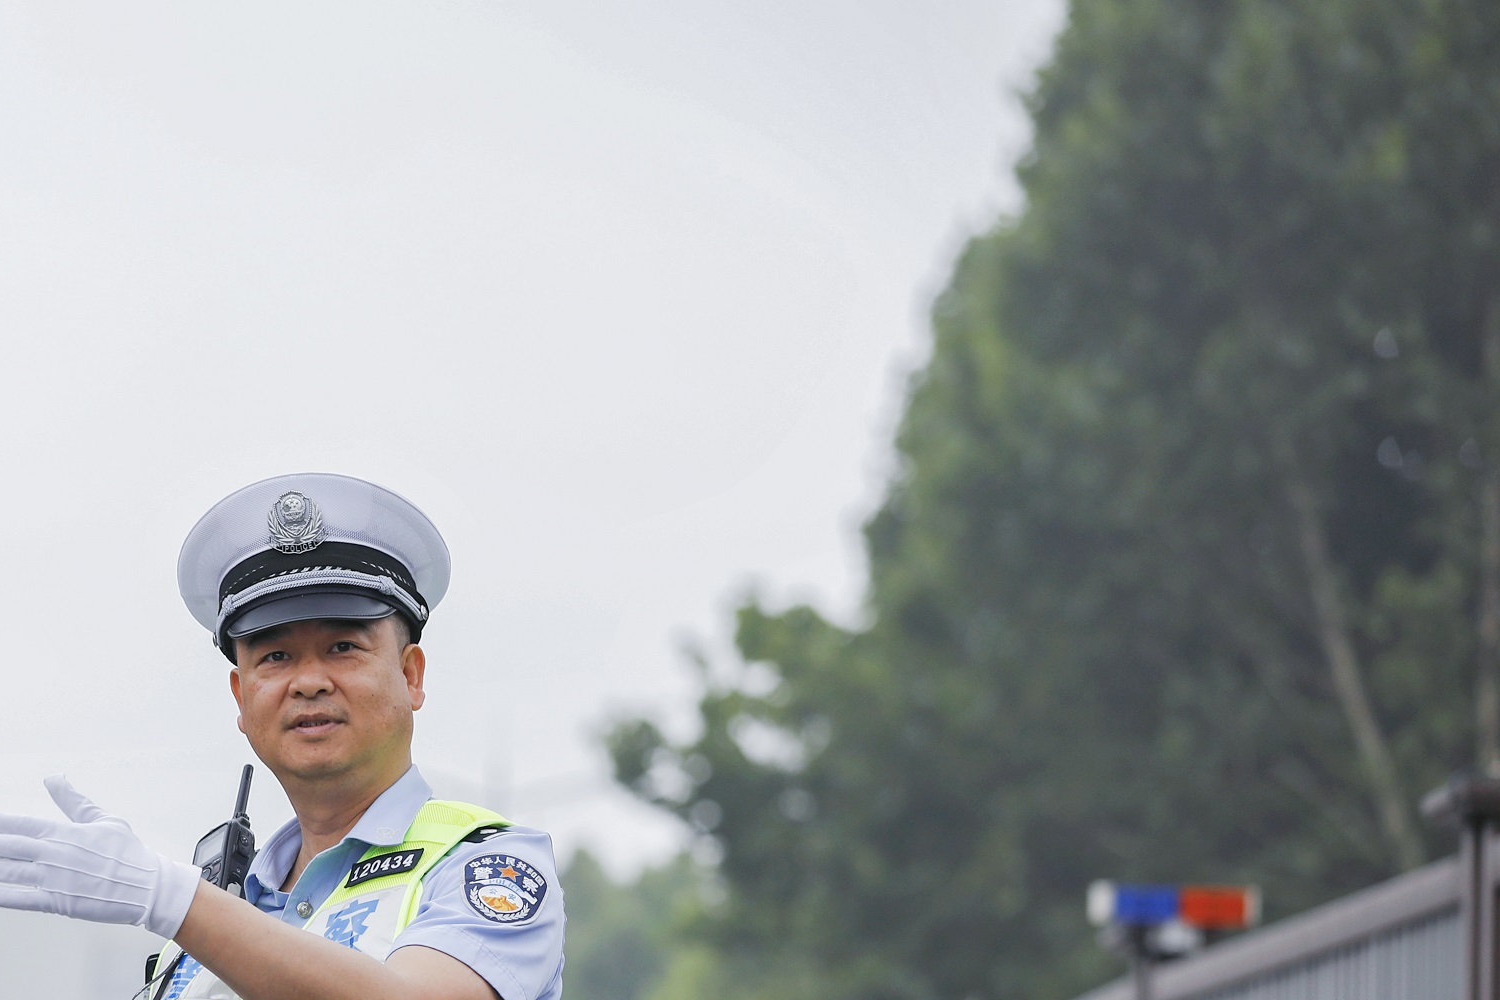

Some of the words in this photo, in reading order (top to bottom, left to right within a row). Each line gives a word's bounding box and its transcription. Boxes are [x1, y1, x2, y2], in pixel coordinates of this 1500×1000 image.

[284, 541, 314, 552] POLICE
[350, 853, 415, 882] 120434
[469, 856, 546, 887] 中华人民共和国
[488, 878, 522, 893] POLICE
